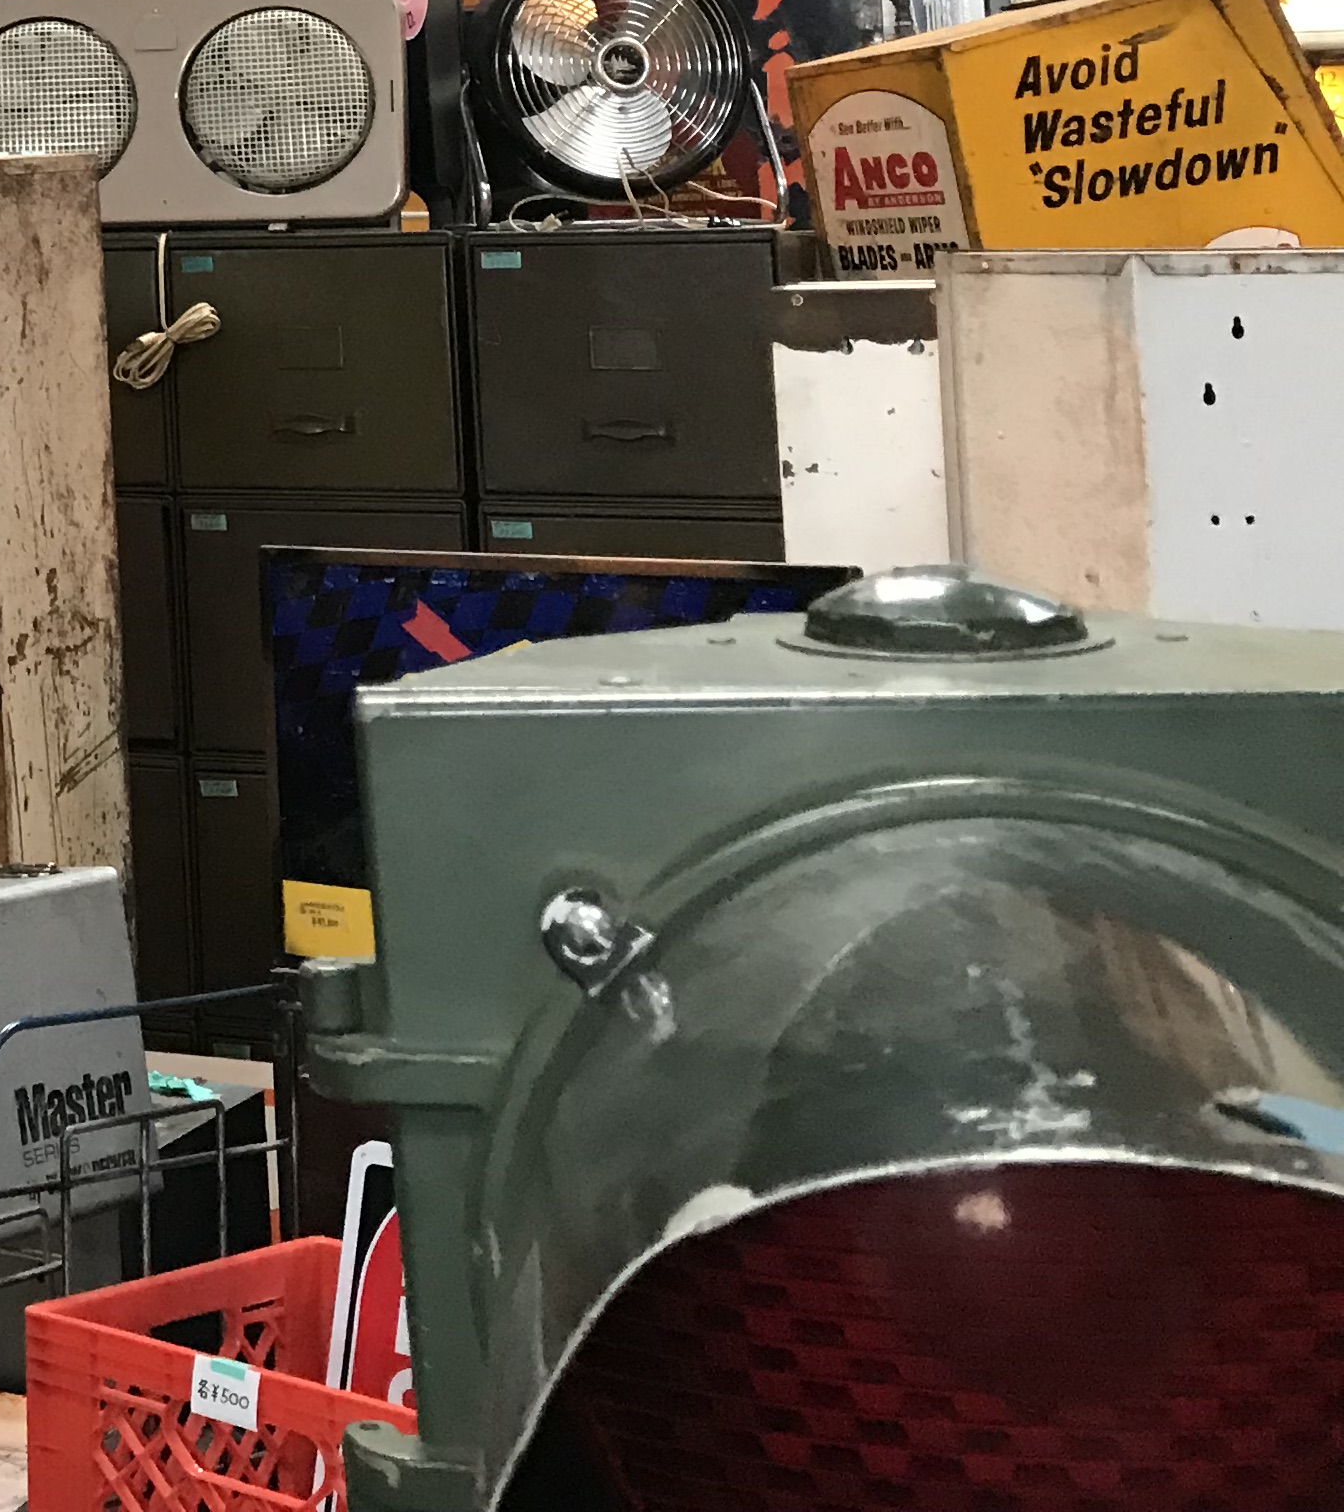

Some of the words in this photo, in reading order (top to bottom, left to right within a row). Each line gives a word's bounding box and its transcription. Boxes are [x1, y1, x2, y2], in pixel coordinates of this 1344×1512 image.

[1014, 43, 1140, 100] Avoid
[1024, 79, 1226, 154] Wasteful
[846, 217, 905, 236] WINDSHIELD
[908, 216, 941, 234] WIPER
[838, 244, 898, 271] BLADES
[913, 241, 959, 270] AR
[14, 1071, 132, 1145] Master
[23, 1137, 80, 1168] SERIS
